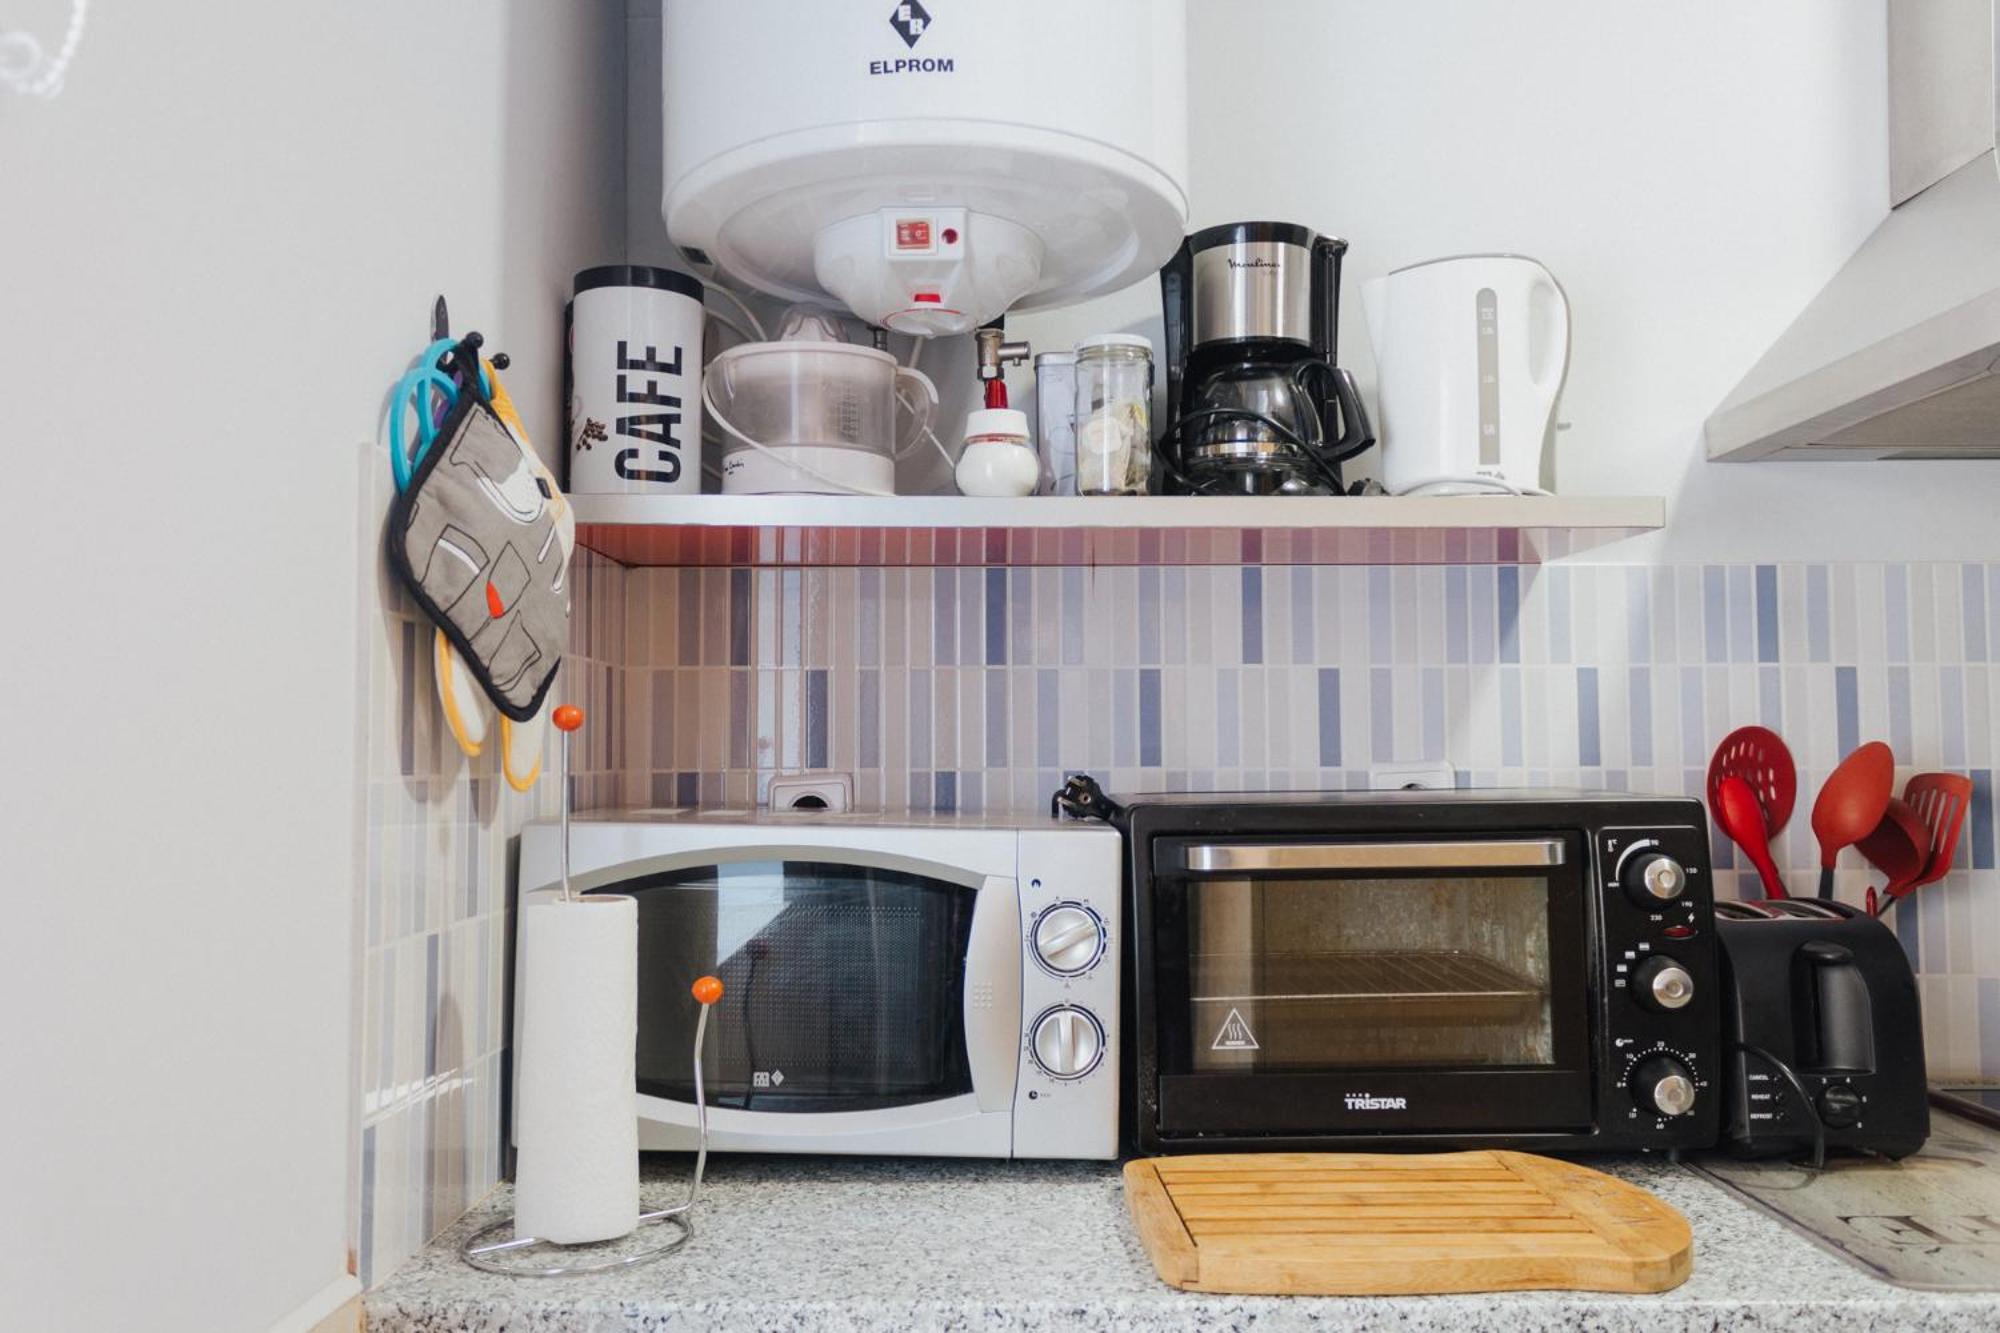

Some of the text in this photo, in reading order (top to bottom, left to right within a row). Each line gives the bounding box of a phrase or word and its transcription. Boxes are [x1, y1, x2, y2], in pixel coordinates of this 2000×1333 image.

[870, 58, 954, 75] ELPROM
[615, 341, 682, 483] CAFE
[1344, 1093, 1407, 1110] TRISTAR
